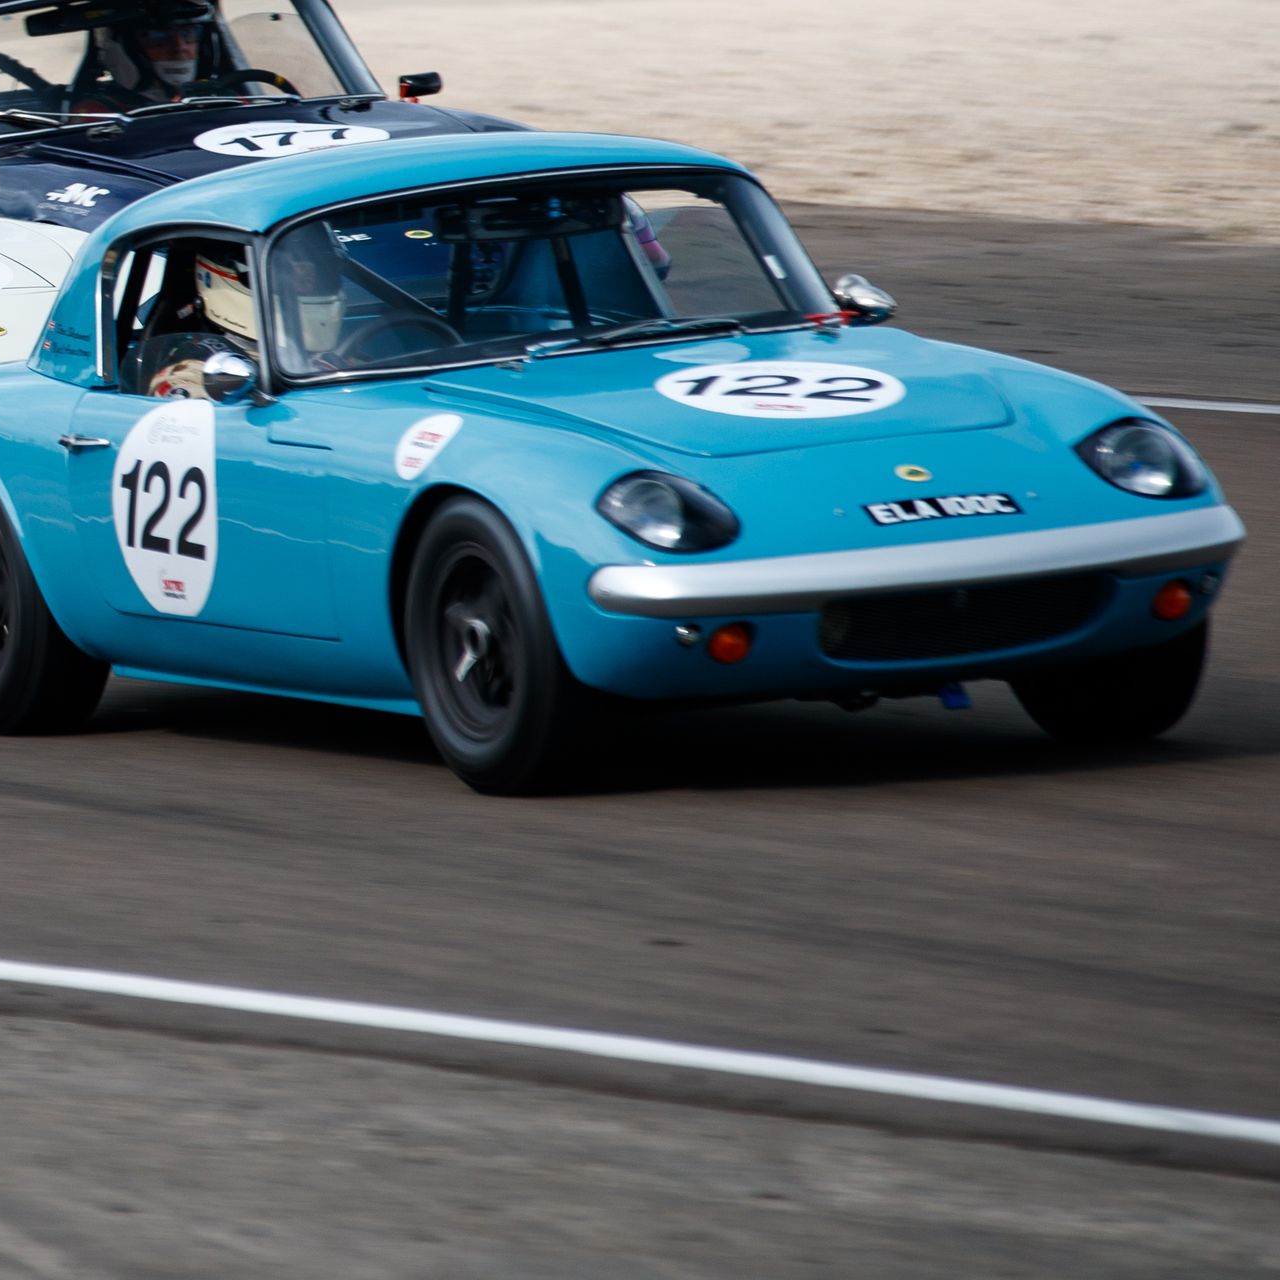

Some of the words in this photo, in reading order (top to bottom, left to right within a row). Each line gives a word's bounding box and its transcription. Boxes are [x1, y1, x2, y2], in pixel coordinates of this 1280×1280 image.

[220, 128, 351, 152] 177
[675, 374, 884, 403] 122
[120, 458, 207, 561] 122
[866, 500, 942, 525] ELA
[936, 494, 1017, 517] 100C
